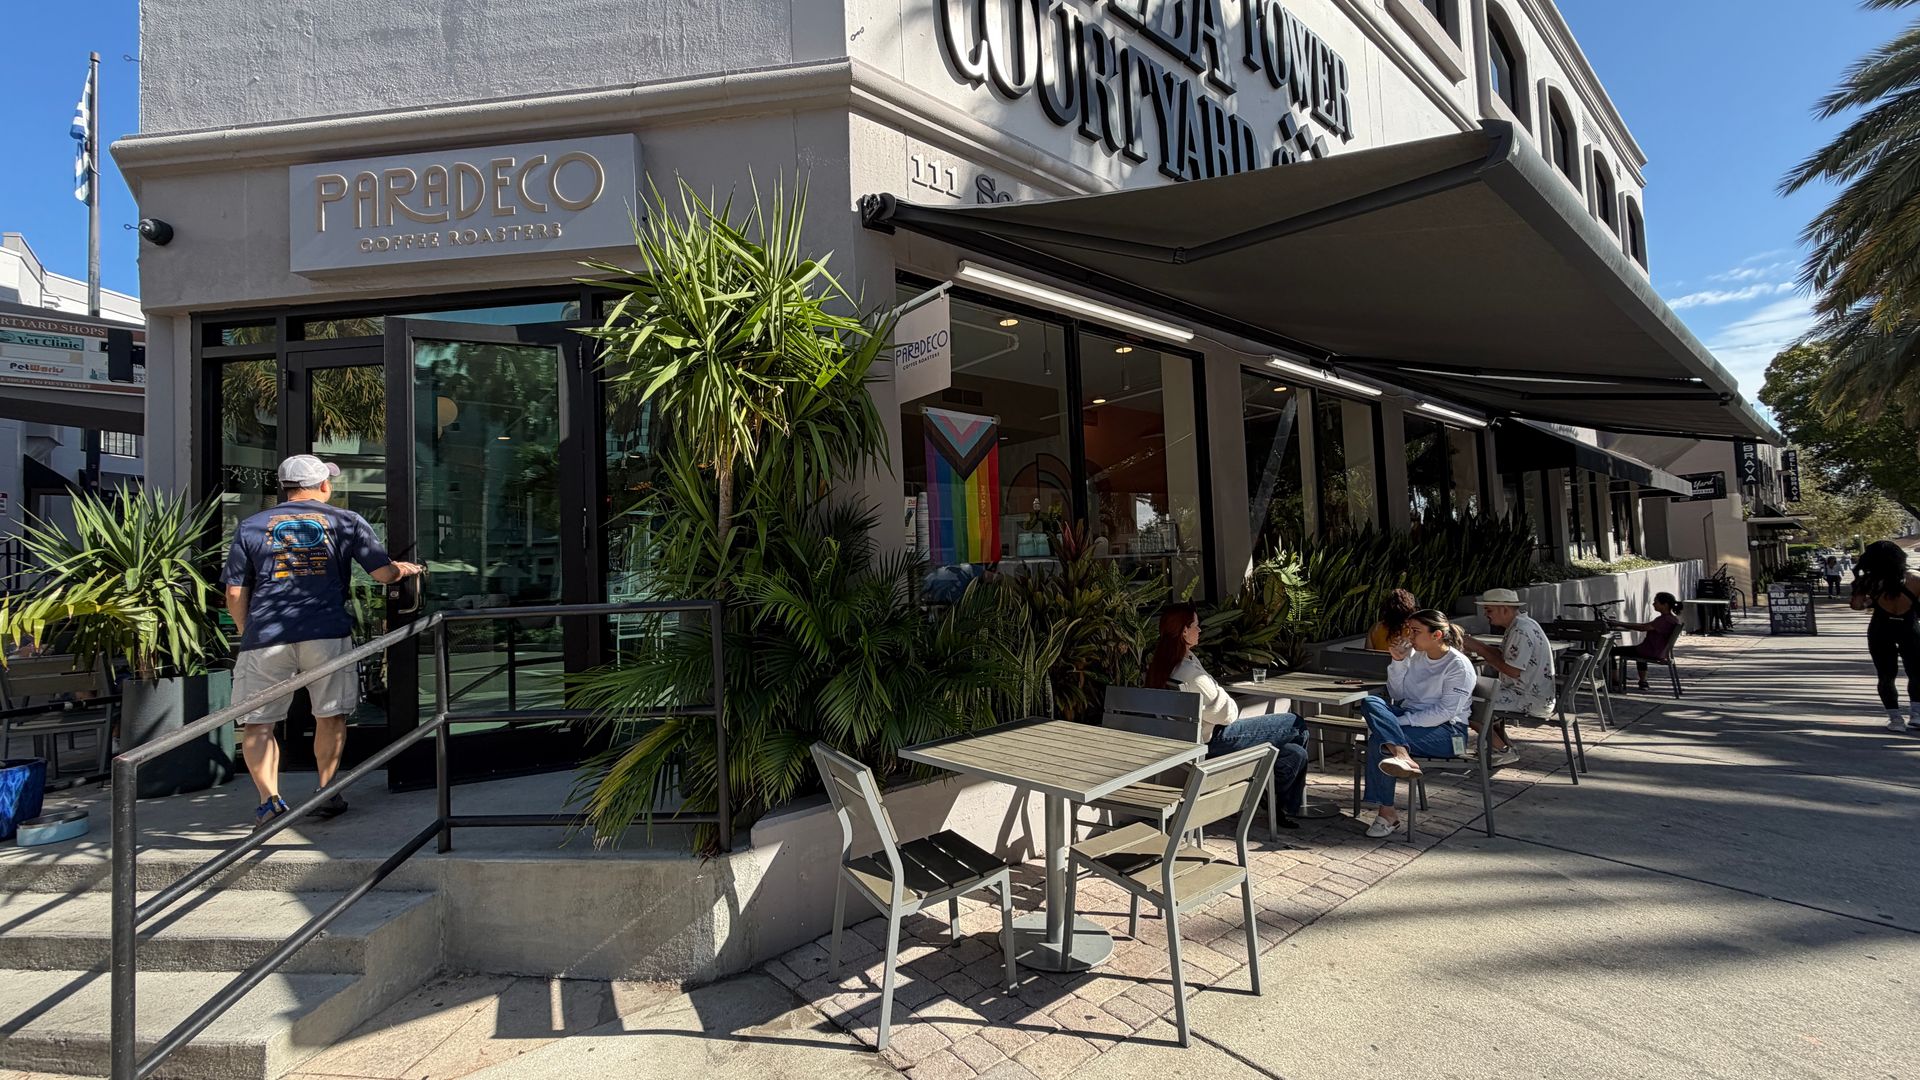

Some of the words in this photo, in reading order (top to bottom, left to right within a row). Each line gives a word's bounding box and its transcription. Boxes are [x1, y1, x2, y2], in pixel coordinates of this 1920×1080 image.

[1241, 0, 1355, 145] TOWER
[314, 151, 605, 232] PARADECO
[911, 153, 961, 199] 111
[359, 232, 440, 252] COFFEE
[449, 222, 563, 245] ROASTERS
[18, 336, 39, 345] Vet
[42, 338, 80, 349] Clinic
[60, 325, 105, 336] SHOPS
[895, 330, 948, 366] PARADECO
[902, 361, 918, 371] COFFEE
[1743, 444, 1756, 482] BRAVA
